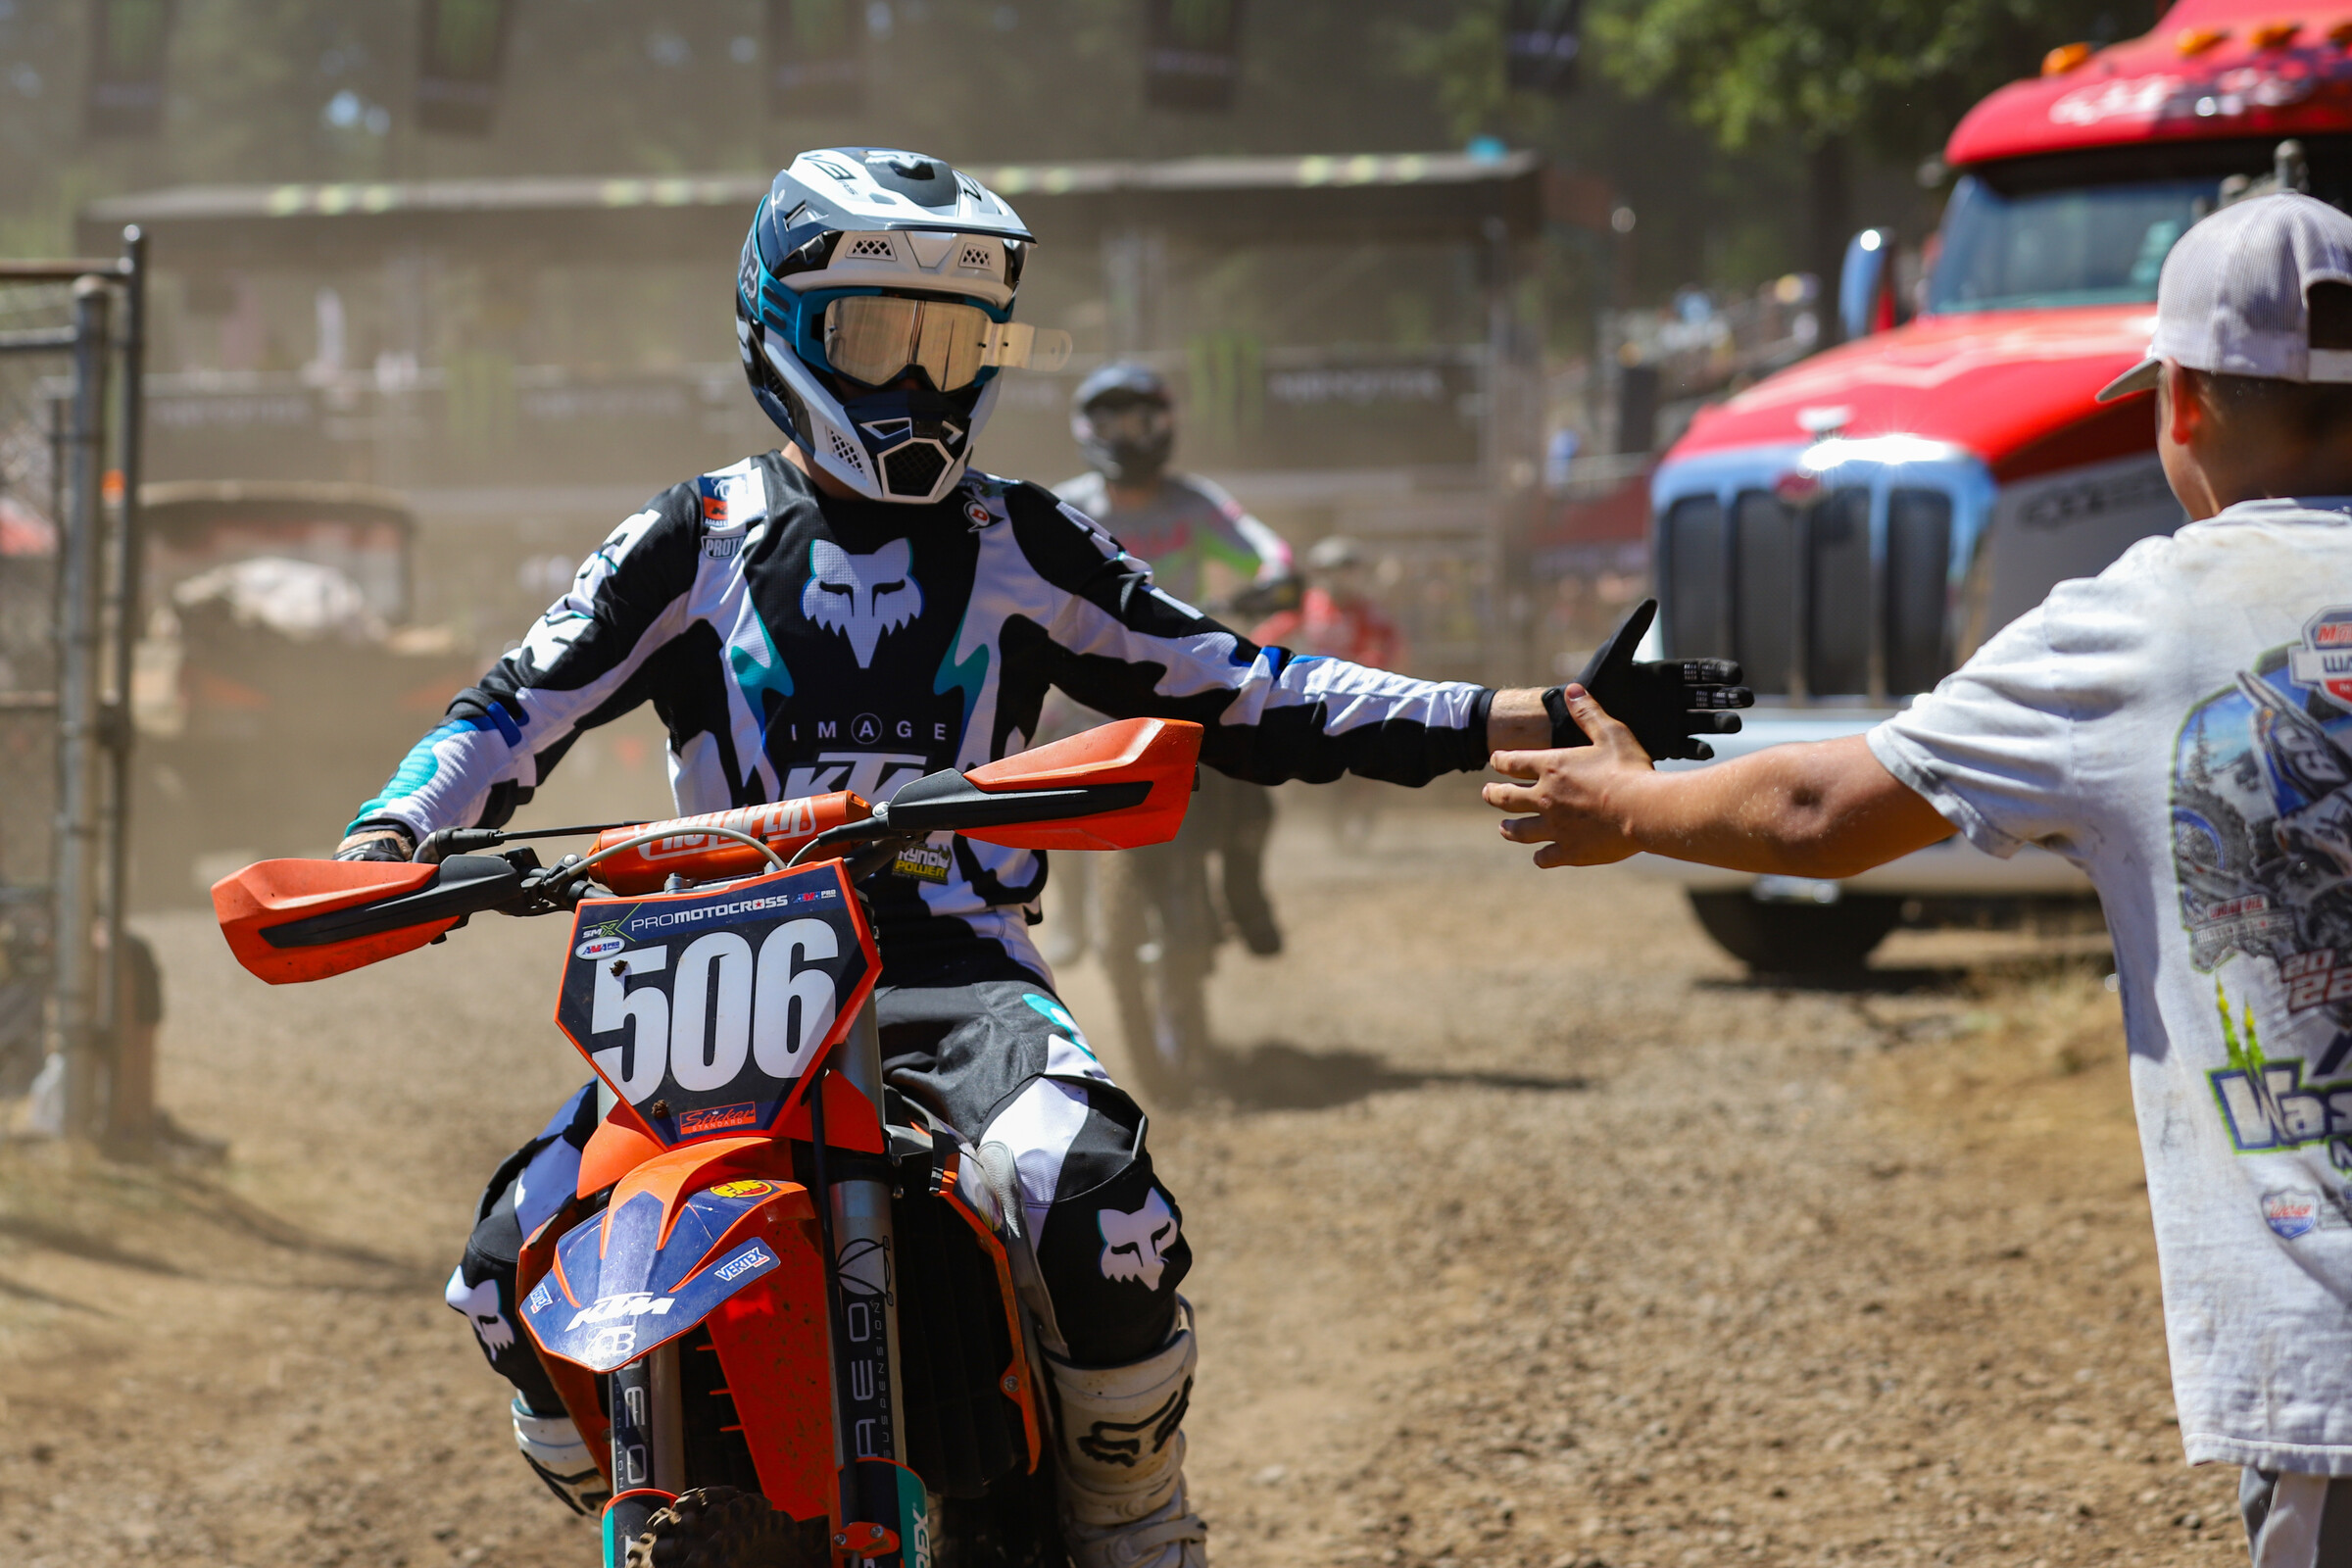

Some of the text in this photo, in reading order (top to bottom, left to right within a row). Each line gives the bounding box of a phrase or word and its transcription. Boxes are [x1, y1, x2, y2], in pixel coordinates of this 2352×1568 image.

[791, 718, 948, 742] IMAGE
[895, 860, 947, 878] POWER
[581, 942, 608, 956] AMA
[591, 917, 839, 1107] 506
[681, 1107, 756, 1129] Sticker
[692, 1117, 744, 1132] STANDARD
[716, 1248, 766, 1280] VERTEX
[564, 1292, 676, 1333] KTM
